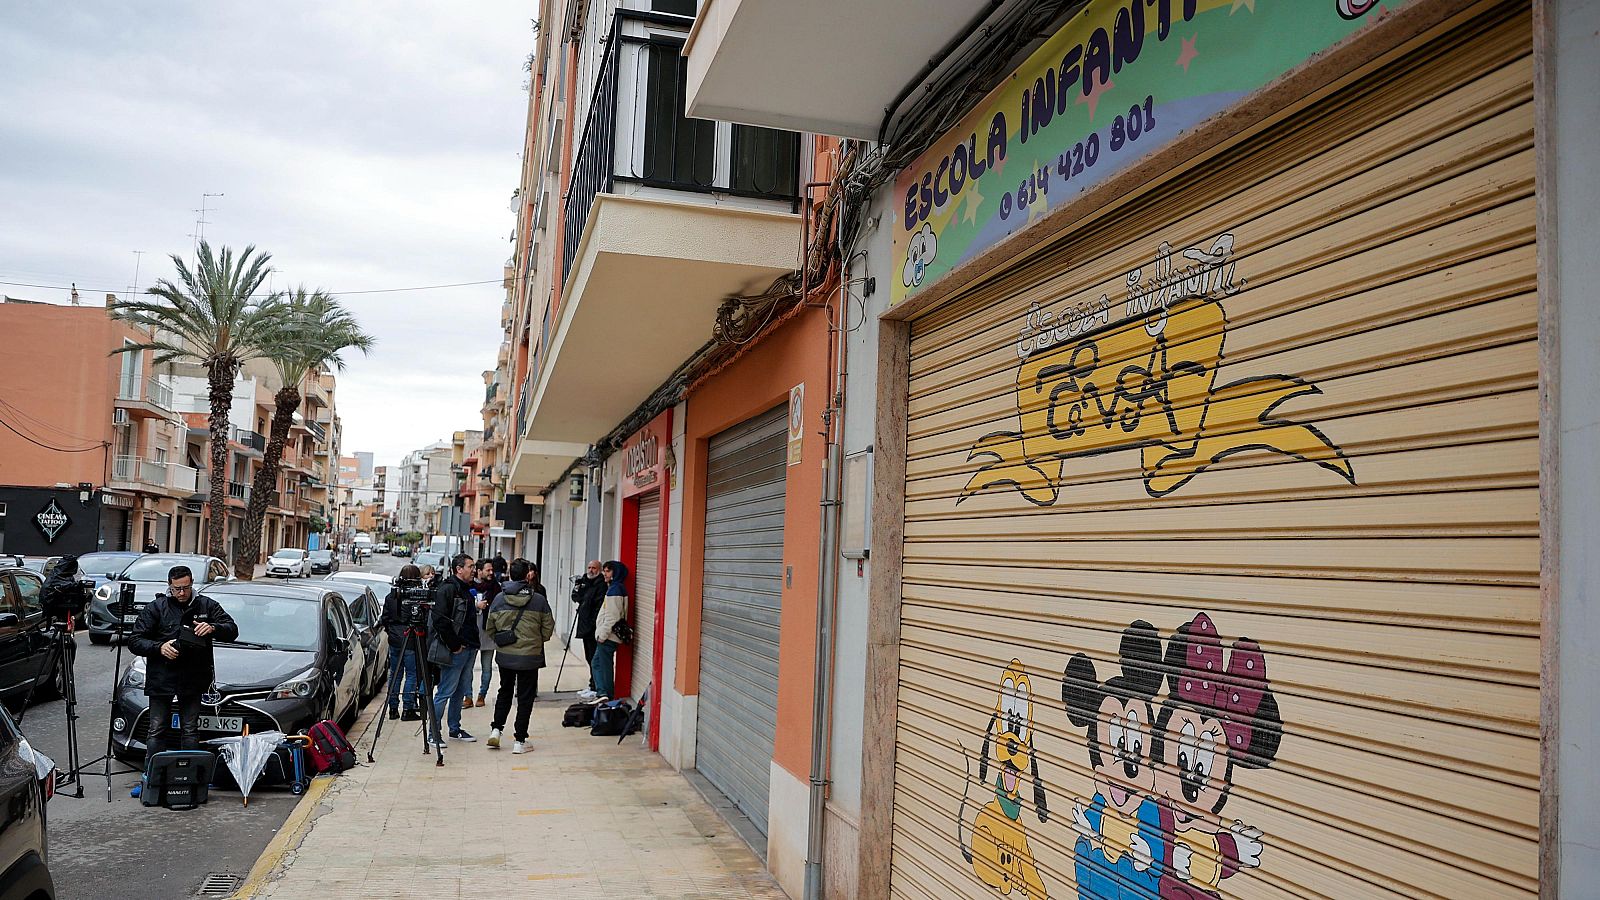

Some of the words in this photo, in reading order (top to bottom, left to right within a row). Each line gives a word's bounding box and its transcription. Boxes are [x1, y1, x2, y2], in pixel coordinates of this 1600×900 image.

[904, 111, 1007, 231] ESCOLA
[1017, 164, 1049, 211] 614
[1057, 132, 1100, 182] 420
[1109, 94, 1156, 152] 801
[37, 513, 68, 521] CINEMA
[215, 718, 238, 730] JKS
